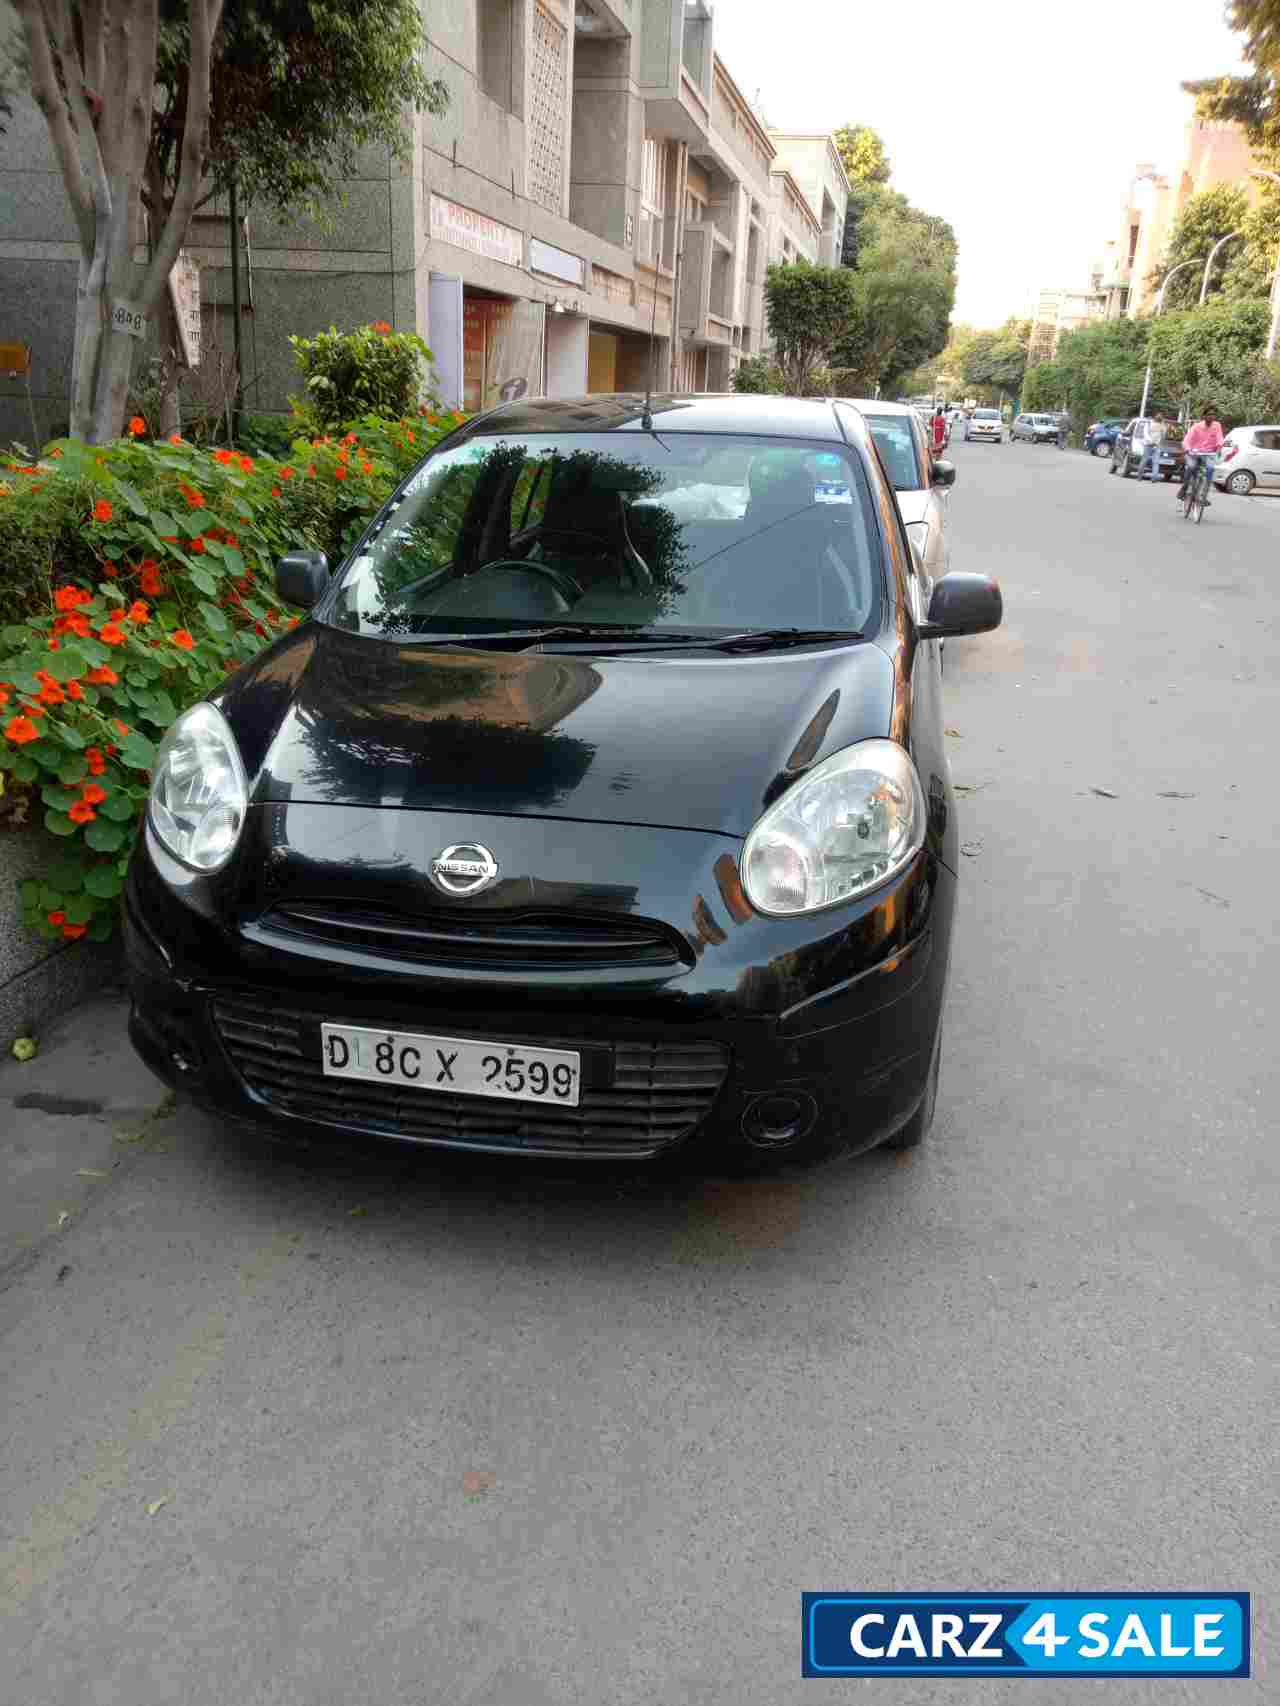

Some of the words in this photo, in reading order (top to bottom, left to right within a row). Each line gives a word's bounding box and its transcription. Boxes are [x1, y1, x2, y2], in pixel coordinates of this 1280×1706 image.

[432, 863, 489, 873] NISSAN
[375, 1043, 421, 1079] 8C
[436, 1049, 458, 1082] X
[481, 1055, 572, 1097] 2599
